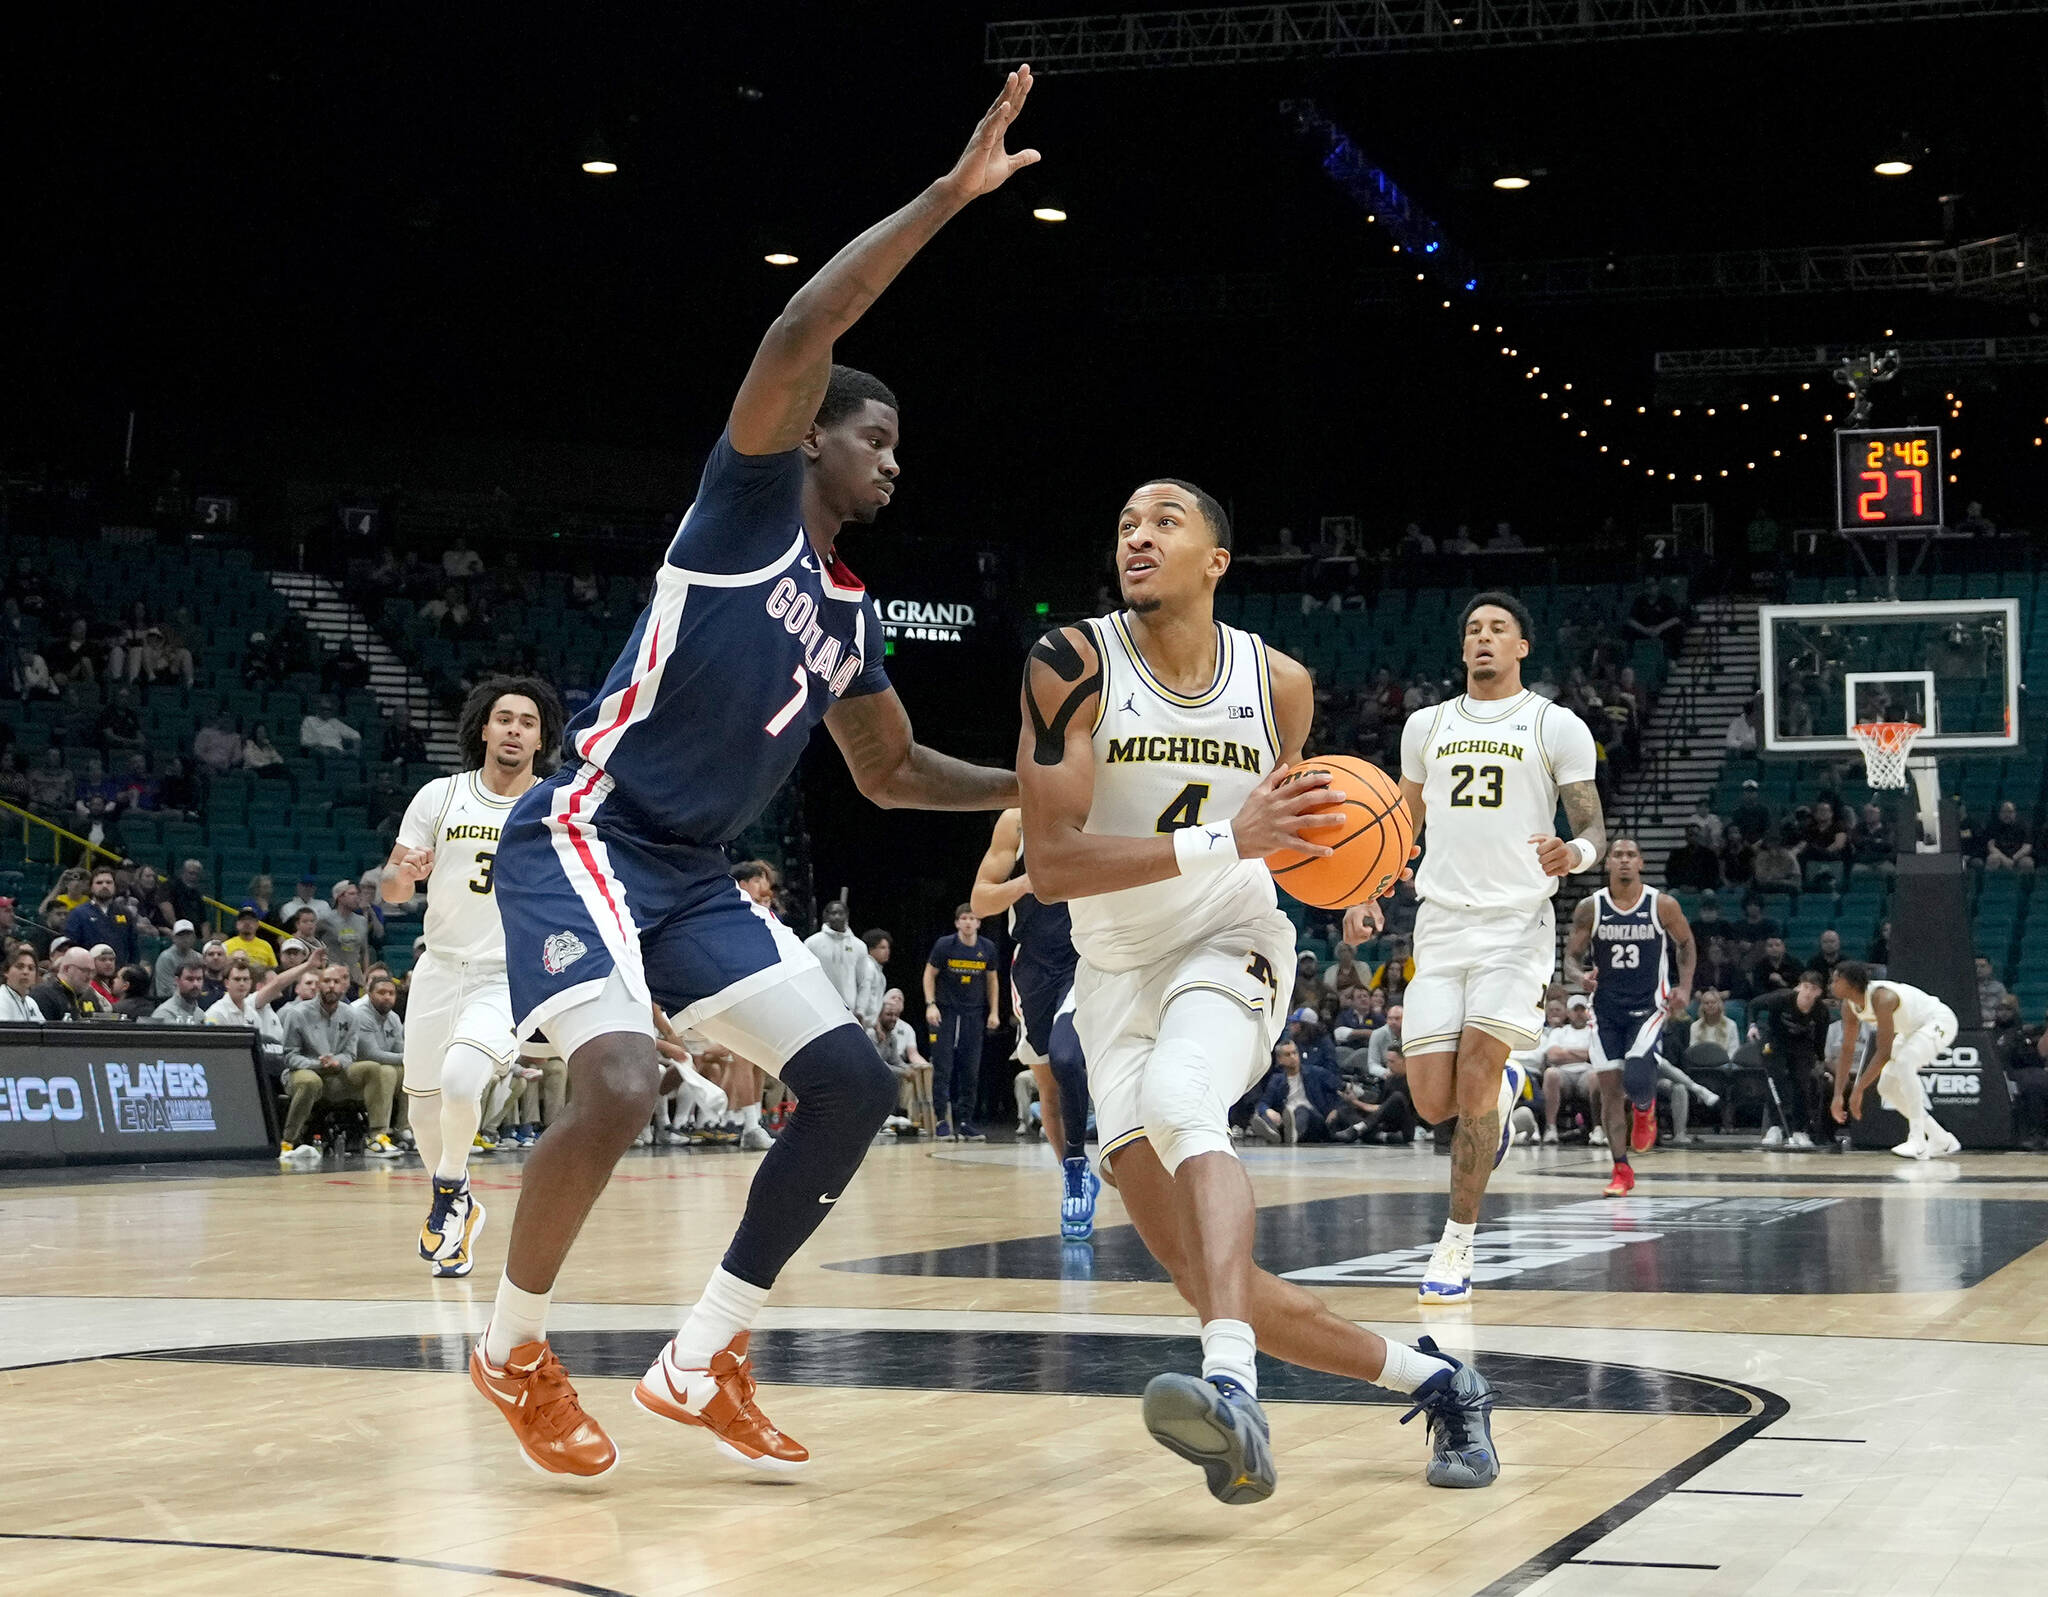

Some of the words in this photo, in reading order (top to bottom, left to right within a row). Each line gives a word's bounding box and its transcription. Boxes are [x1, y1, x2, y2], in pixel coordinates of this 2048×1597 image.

[1867, 439, 1930, 469] 2:46
[1858, 469, 1923, 521] 27
[887, 599, 974, 626] GRAND
[881, 626, 898, 639] N
[904, 627, 962, 643] ARENA
[1106, 736, 1262, 776] MICHIGAN
[1435, 739, 1525, 762] MICHIGAN
[1450, 764, 1505, 809] 23
[1155, 781, 1211, 835] 4
[446, 824, 500, 842] MICHI
[469, 851, 497, 895] 3
[1598, 923, 1656, 941] GONZAGA
[1611, 943, 1640, 969] 23
[105, 1060, 209, 1110] PLAYERS
[1920, 1073, 1981, 1095] YERS
[118, 1097, 172, 1132] ERA
